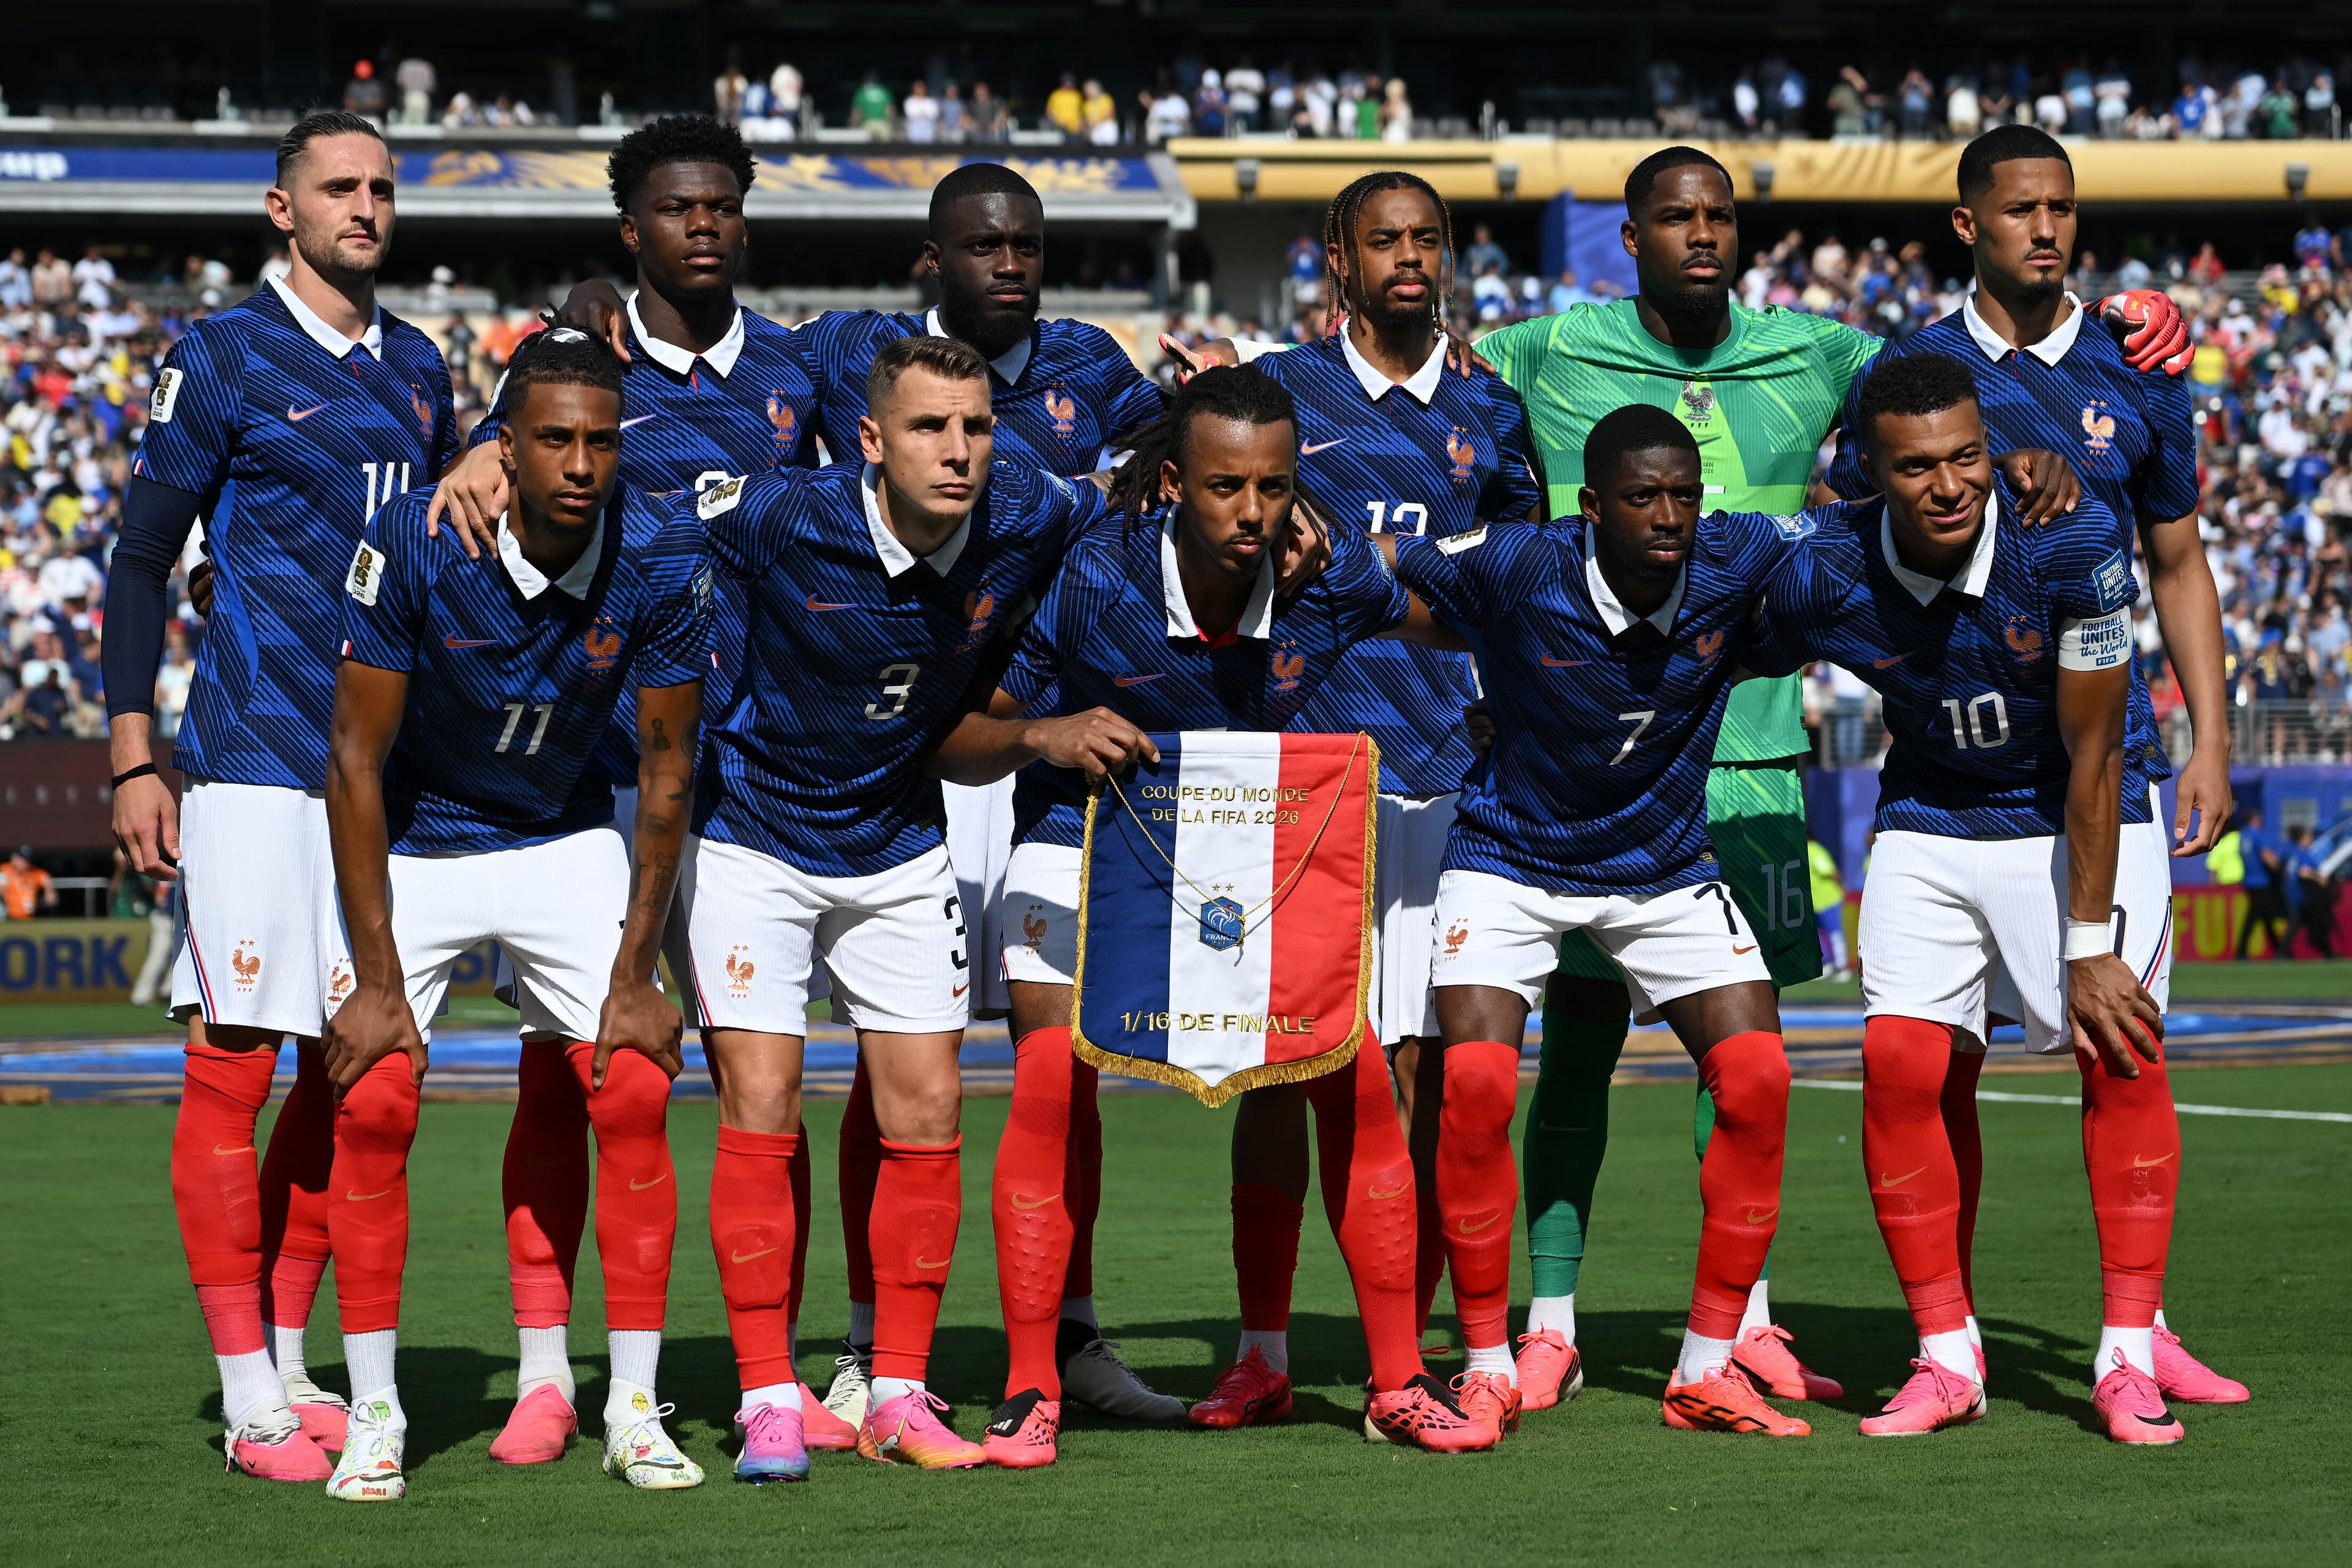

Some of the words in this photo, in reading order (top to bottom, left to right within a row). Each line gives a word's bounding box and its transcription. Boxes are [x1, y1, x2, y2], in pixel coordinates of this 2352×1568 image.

[0, 151, 69, 181] up
[2100, 559, 2122, 580] FOOTBALL
[2103, 566, 2125, 590] UNITES
[2104, 590, 2114, 600] the
[2114, 592, 2123, 601] FIFA
[2081, 625, 2125, 644] UNITES
[2082, 615, 2123, 631] FOOTBALL
[2078, 646, 2099, 657] the
[2101, 636, 2128, 655] World
[2097, 655, 2116, 666] FIFA
[864, 664, 919, 720] 3
[495, 703, 554, 755] 11
[1942, 691, 2010, 749] 10
[1609, 710, 1656, 766] 7
[1142, 786, 1204, 801] COUPE
[1210, 787, 1235, 802] DU
[1242, 788, 1310, 802] MONDE
[1152, 809, 1177, 821] DE
[1182, 809, 1204, 824] LA
[1210, 810, 1247, 825] FIFA
[1254, 810, 1298, 824] 2026
[1762, 859, 1805, 931] 16
[1693, 883, 1739, 935] 7
[944, 895, 968, 970] 3
[1120, 1011, 1170, 1031] 1/16
[1180, 1013, 1214, 1031] DE
[1222, 1014, 1315, 1035] FINALE
